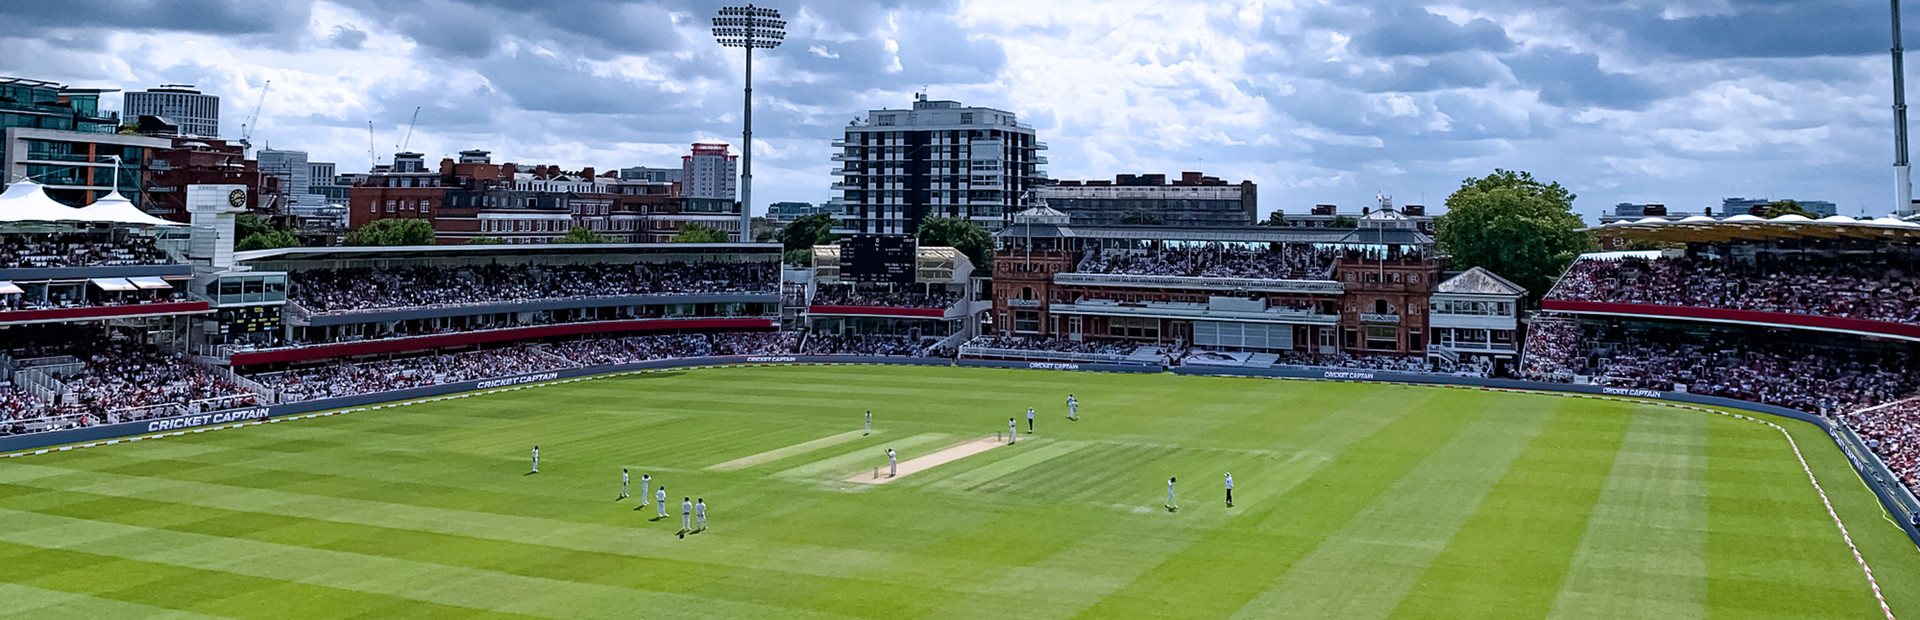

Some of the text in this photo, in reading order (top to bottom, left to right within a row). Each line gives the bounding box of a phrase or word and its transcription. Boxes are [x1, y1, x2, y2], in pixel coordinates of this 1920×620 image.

[477, 372, 558, 389] CRICKET CAPTAIN
[148, 408, 269, 432] CRICKET CAPTAIN
